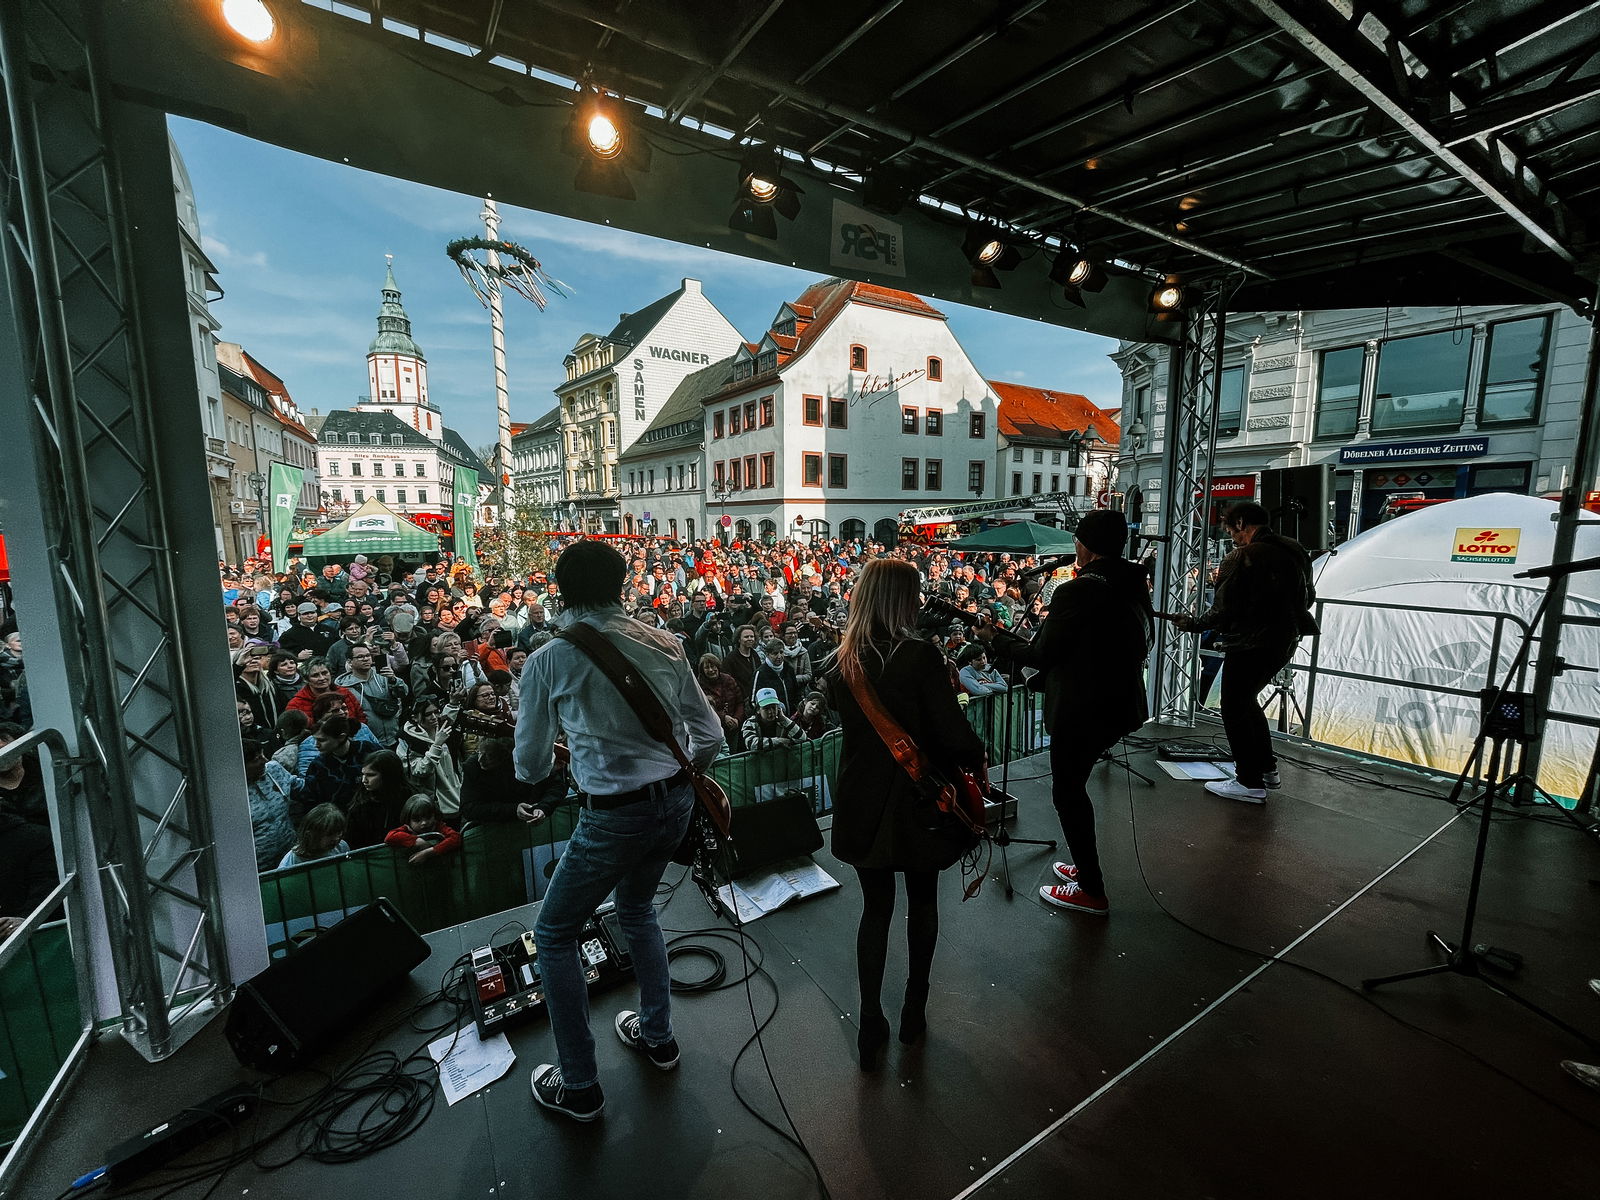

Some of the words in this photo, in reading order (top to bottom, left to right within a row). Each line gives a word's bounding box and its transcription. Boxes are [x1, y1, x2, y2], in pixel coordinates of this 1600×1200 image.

[649, 346, 710, 365] WAGNER
[634, 358, 645, 421] SAMEN
[1343, 450, 1385, 459] DÖBELNER
[1386, 447, 1441, 456] ALLGEMEINE
[1442, 443, 1484, 453] ZEITUNG
[1211, 483, 1246, 491] odafone
[1458, 544, 1511, 554] LOTTO
